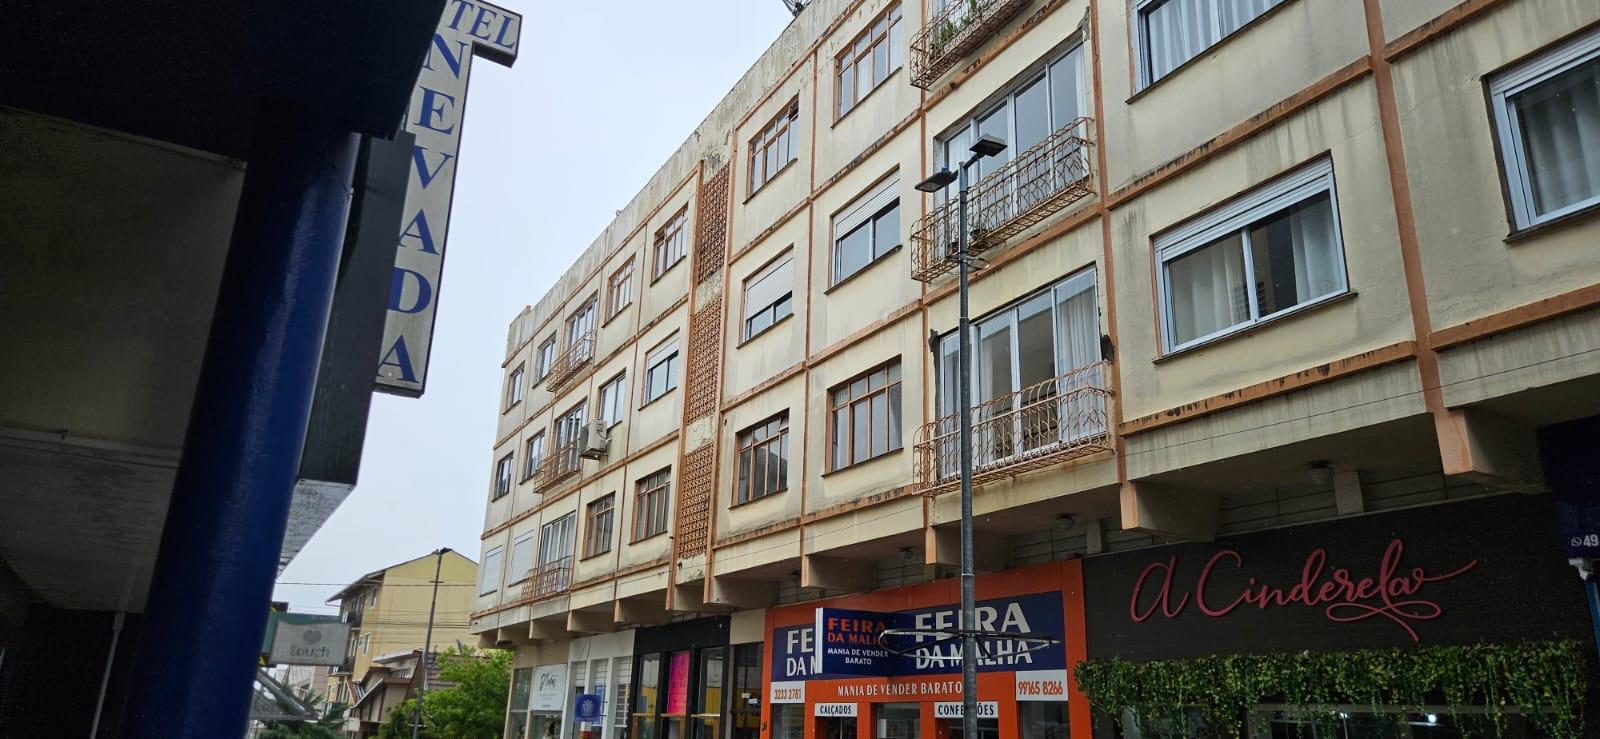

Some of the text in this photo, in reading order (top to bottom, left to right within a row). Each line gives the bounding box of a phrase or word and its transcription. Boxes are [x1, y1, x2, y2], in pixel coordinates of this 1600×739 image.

[447, 0, 516, 49] TEL
[377, 33, 470, 383] NEVADA
[1583, 533, 1599, 547] 49
[1196, 538, 1480, 643] Cinderela
[827, 617, 886, 634] FEIRA
[915, 601, 1032, 643] FEIRA
[827, 632, 889, 646] DA MALHA
[290, 644, 330, 659] touch
[827, 648, 889, 658] MANIA DE VENDER
[915, 643, 945, 670] DA
[786, 656, 807, 677] DA
[845, 656, 872, 665] BARATO
[837, 681, 963, 697] MANIA DE VENDER BARATO
[1018, 681, 1064, 696] 99165 8266
[820, 703, 852, 716] CALÇADOS
[938, 702, 994, 716] CONFEÕES
